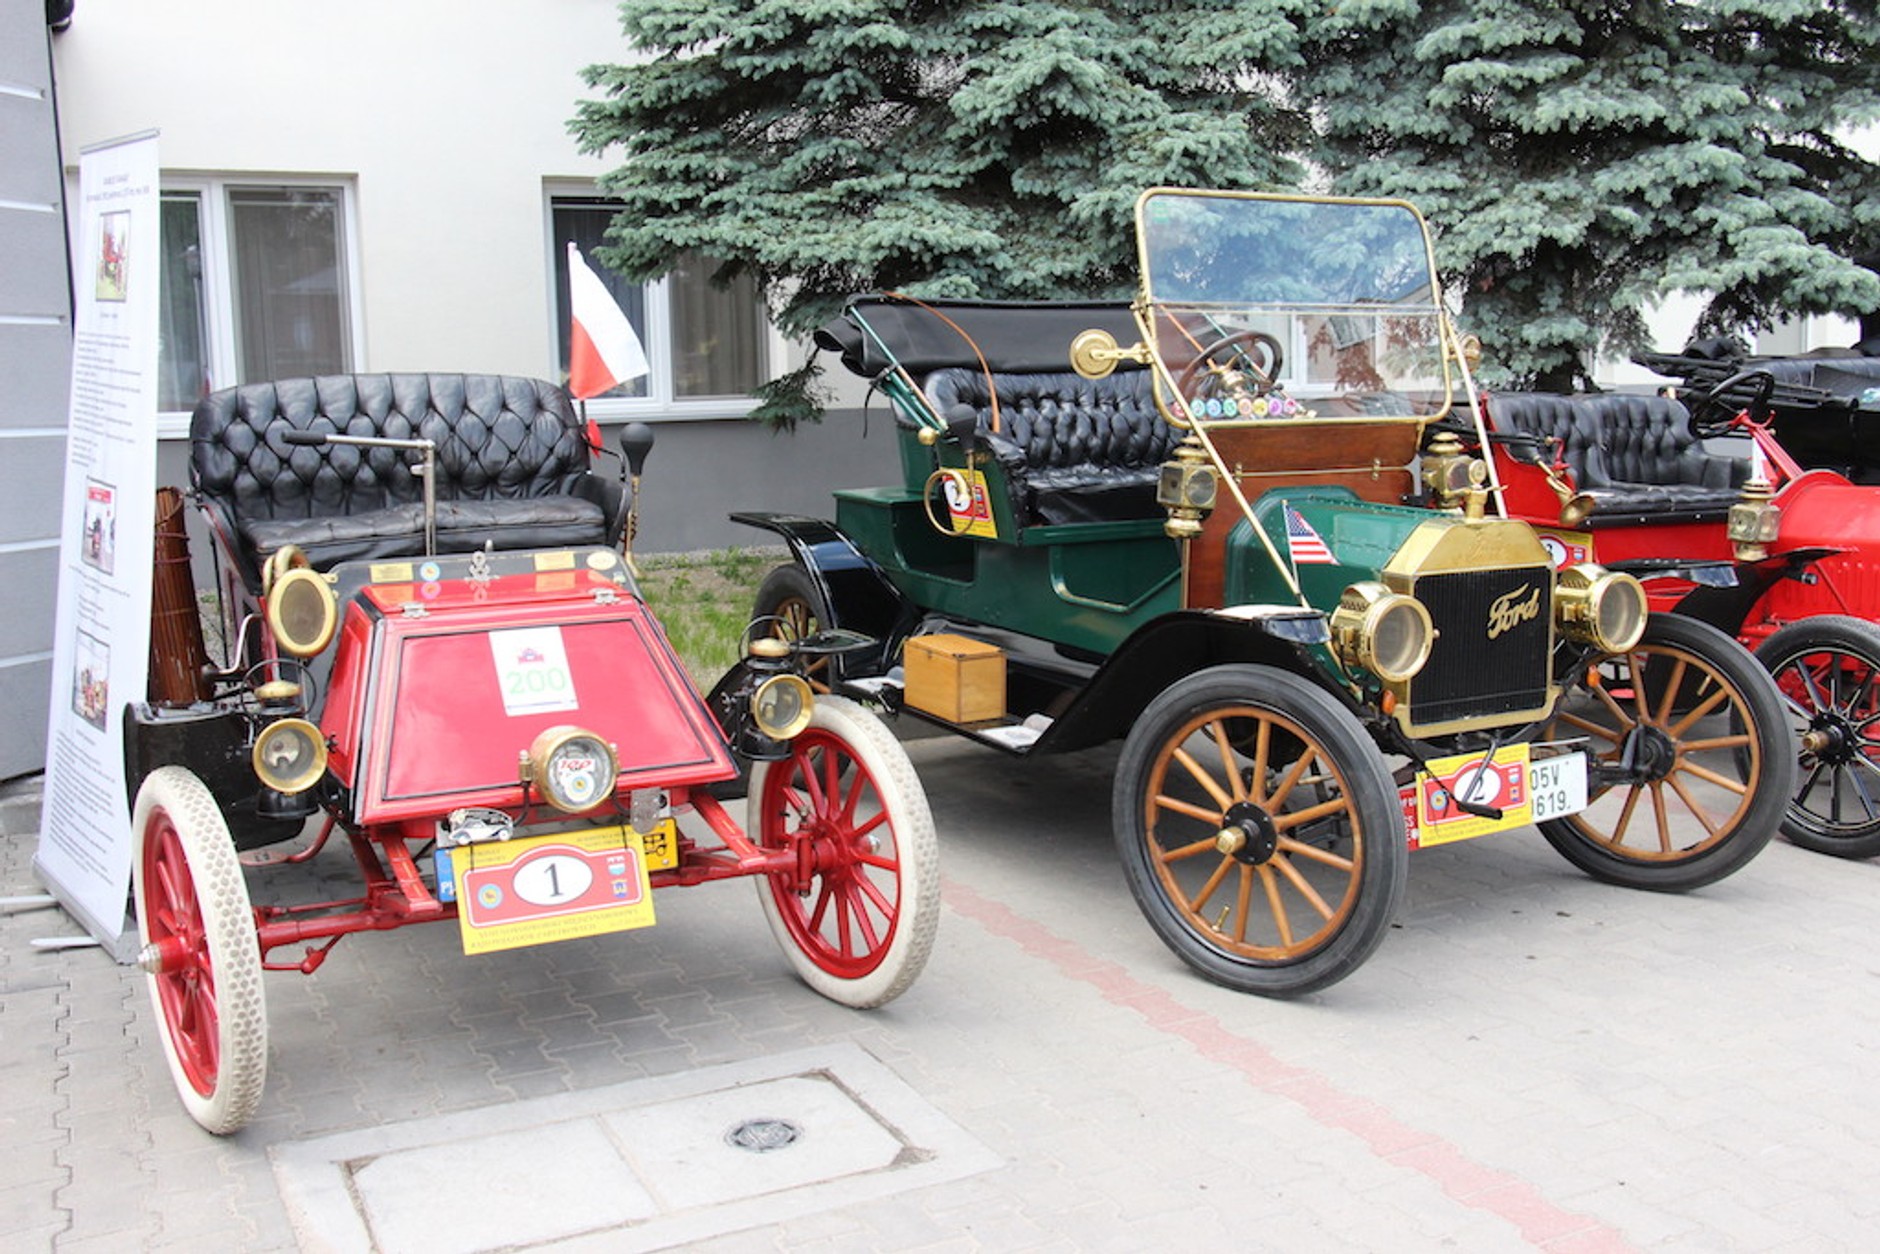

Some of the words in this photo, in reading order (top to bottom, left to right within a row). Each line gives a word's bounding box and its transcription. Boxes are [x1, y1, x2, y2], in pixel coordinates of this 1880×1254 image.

[1487, 582, 1541, 640] Ford
[506, 667, 568, 695] 200
[1530, 764, 1560, 790] 05V
[1531, 790, 1567, 817] 619
[543, 863, 564, 898] 1
